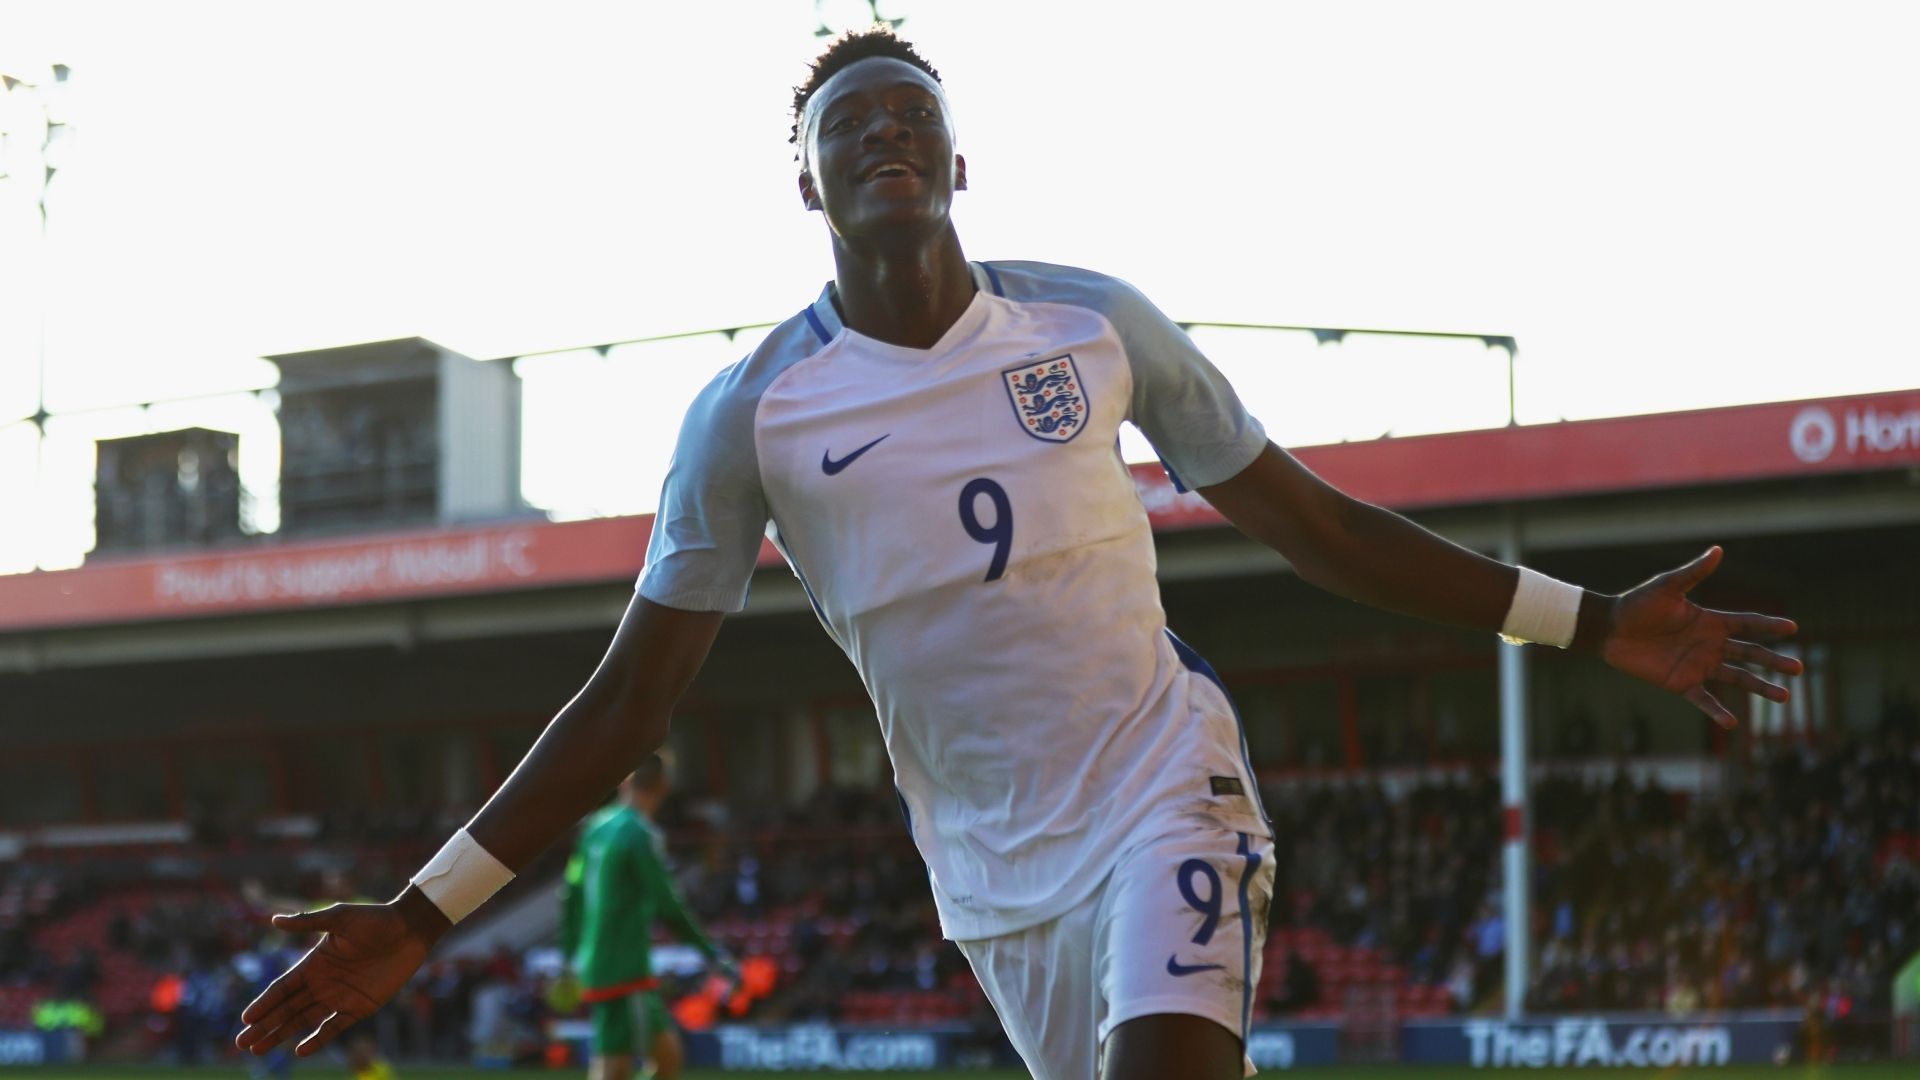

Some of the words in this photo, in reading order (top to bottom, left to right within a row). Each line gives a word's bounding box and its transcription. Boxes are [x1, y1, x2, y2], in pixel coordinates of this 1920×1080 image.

[958, 477, 1014, 583] 9
[1177, 858, 1223, 946] 9
[716, 1022, 937, 1071] TheFA.com
[1463, 1017, 1732, 1069] TheFA.com
